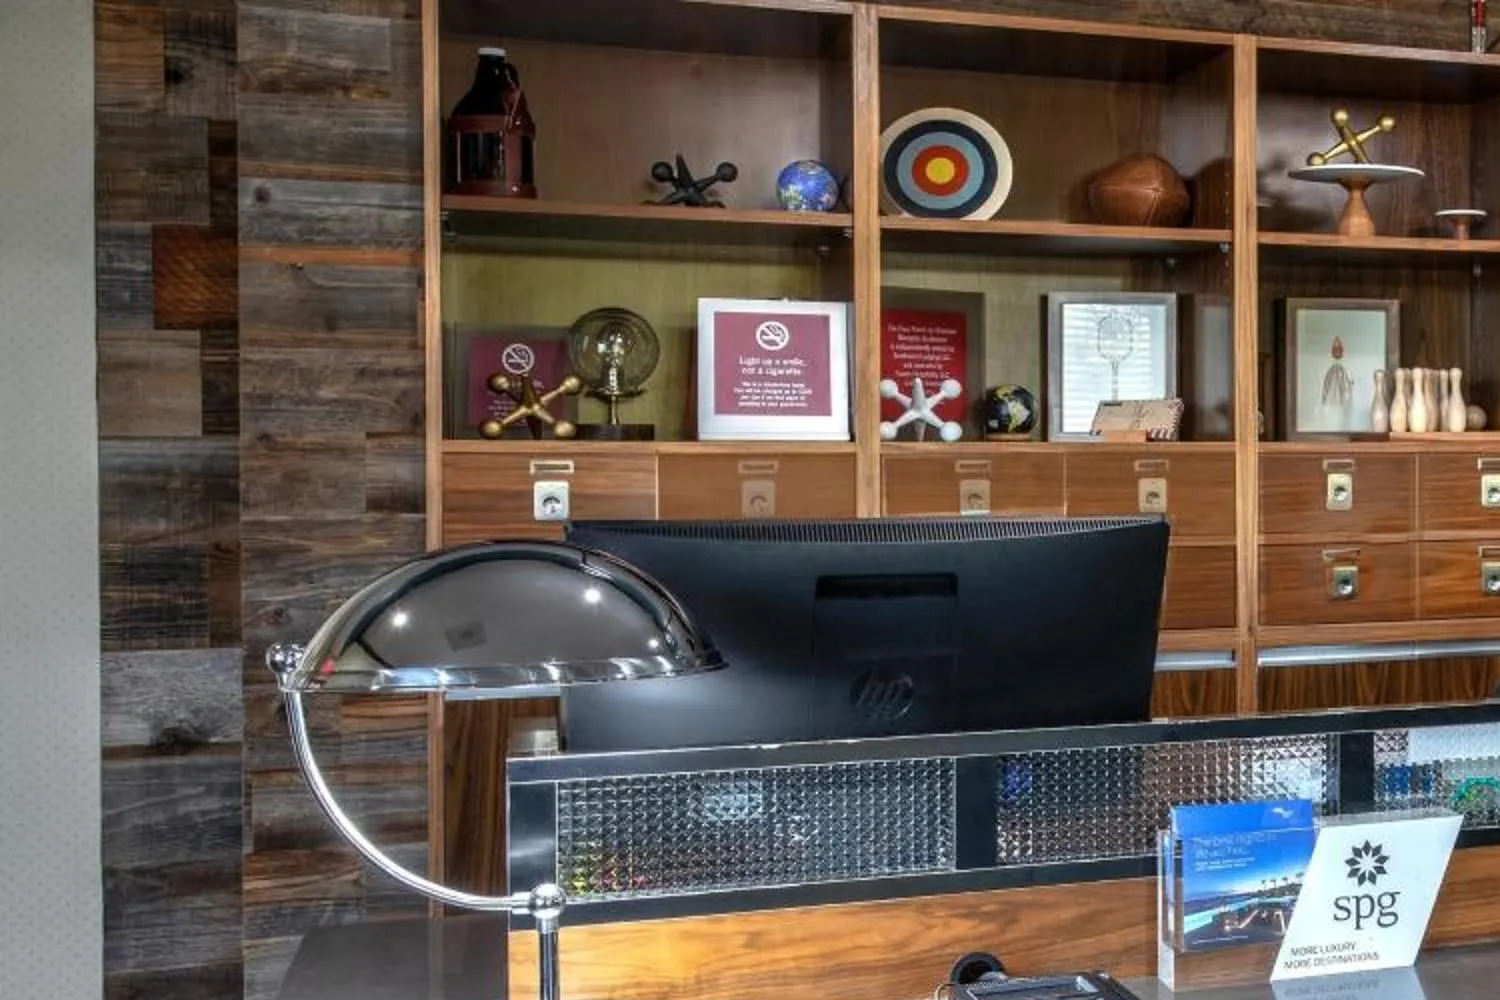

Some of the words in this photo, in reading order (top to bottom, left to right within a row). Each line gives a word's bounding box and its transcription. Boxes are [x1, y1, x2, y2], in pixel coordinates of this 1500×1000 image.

[1333, 890, 1401, 930] spg
[1291, 945, 1318, 957] MORE
[1283, 957, 1311, 970] MORE
